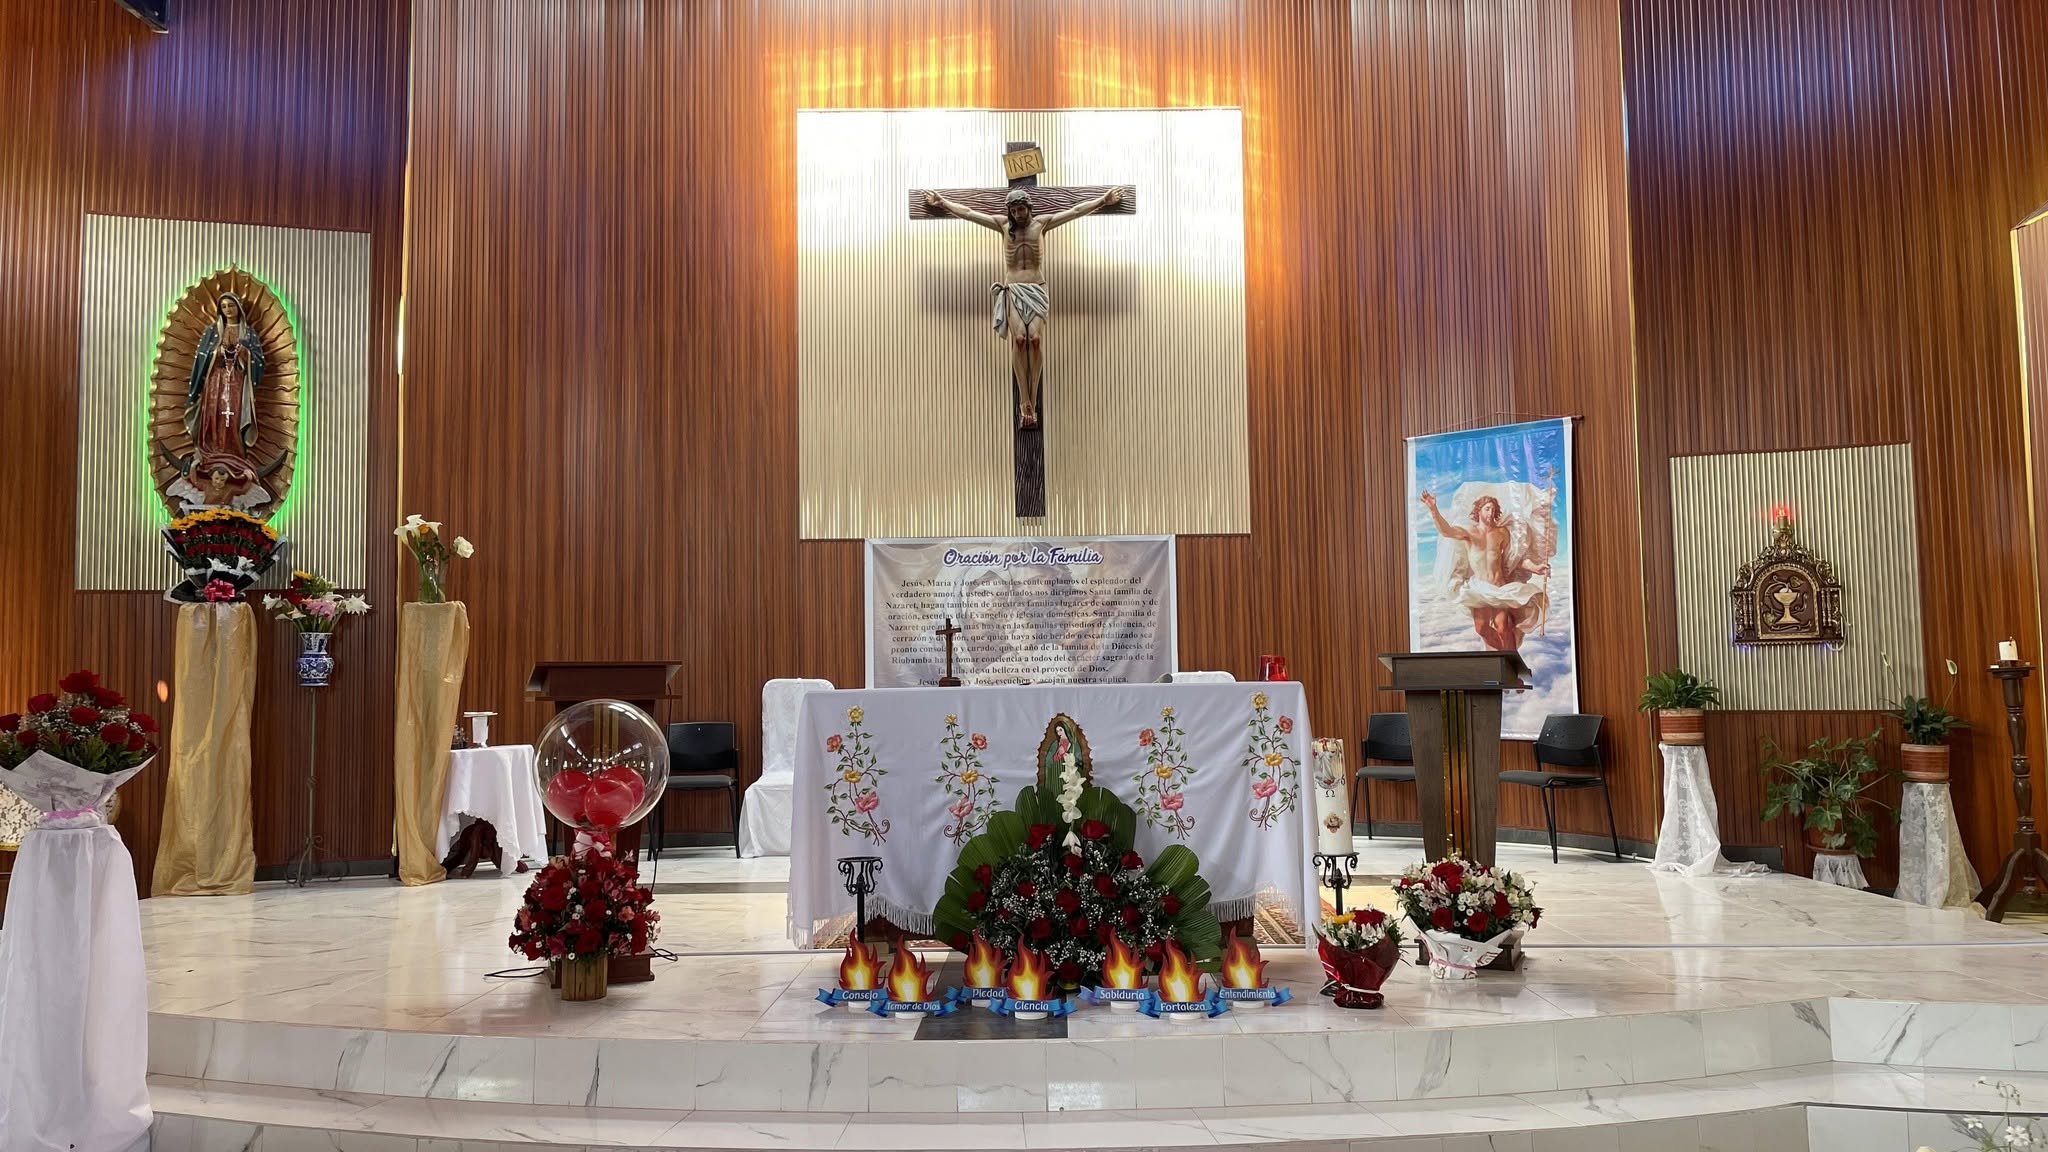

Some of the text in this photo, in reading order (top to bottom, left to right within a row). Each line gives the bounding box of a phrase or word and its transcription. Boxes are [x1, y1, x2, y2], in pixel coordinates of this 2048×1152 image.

[1008, 153, 1040, 173] INRI
[943, 547, 1102, 568] Oración por la Familia
[902, 579, 925, 589] Jesús,
[928, 579, 951, 587] María
[993, 578, 1021, 586] ustedes
[1024, 577, 1079, 588] contemplamos
[1082, 577, 1088, 585] el
[1090, 577, 1128, 587] esplendor
[1130, 577, 1141, 585] del
[892, 590, 931, 598] verdadero
[966, 589, 994, 597] ustedes
[1050, 588, 1087, 598] dirigimos
[1090, 587, 1111, 596] Santa
[1114, 587, 1140, 595] familia
[1143, 587, 1152, 595] de
[886, 598, 1158, 611] Nazaret, hagan también de nuestras familias lugares de comunión y de
[888, 612, 920, 622] oración,
[922, 612, 953, 620] escuelas
[956, 611, 967, 620] del
[1016, 610, 1044, 621] iglesias
[1093, 609, 1115, 618] Santa
[1117, 609, 1145, 617] familia
[1147, 609, 1155, 617] de
[889, 623, 918, 631] Nazaret
[921, 625, 935, 633] que
[982, 622, 1000, 632] haya
[1014, 622, 1024, 630] las
[1026, 621, 1057, 630] familias
[1060, 621, 1095, 631] episodios
[1148, 620, 1156, 628] de
[929, 636, 933, 644] y
[936, 633, 969, 644] divión,
[970, 635, 985, 643] que
[988, 634, 1009, 643] quien
[1012, 633, 1030, 643] haya
[1032, 632, 1048, 641] sido
[1050, 632, 1076, 640] herido
[1084, 631, 1138, 640] escandalizado
[891, 646, 917, 655] pronto
[968, 644, 997, 654] curado,
[998, 646, 1013, 654] que
[1016, 644, 1022, 652] el
[1024, 644, 1038, 652] año
[1040, 643, 1051, 652] de
[1052, 643, 1060, 651] la
[1062, 643, 1089, 651] familia
[1112, 642, 1143, 651] Diócesis
[1145, 642, 1154, 650] de
[892, 656, 932, 664] Riobamba
[982, 655, 1022, 663] conciencia
[1032, 654, 1052, 662] todos
[1054, 654, 1066, 662] del
[1102, 653, 1133, 663] sagrado
[1136, 653, 1145, 661] de
[1147, 653, 1154, 661] la
[970, 666, 980, 674] de
[992, 666, 1019, 674] belleza
[1032, 665, 1040, 673] el
[1042, 665, 1075, 675] proyecto
[1078, 665, 1087, 673] de
[1089, 664, 1109, 673] Dios.
[1068, 676, 1097, 684] nuestra
[1325, 789, 1336, 798] Ω
[842, 990, 878, 1000] Consejo
[973, 988, 1004, 998] Piedad
[1100, 989, 1145, 1000] Sabiduría
[1219, 988, 1276, 999] Entendimiento
[886, 1002, 941, 1011] Temor de Dios
[1015, 1001, 1049, 1011] Ciencia
[1161, 1002, 1206, 1012] Fortaleza
